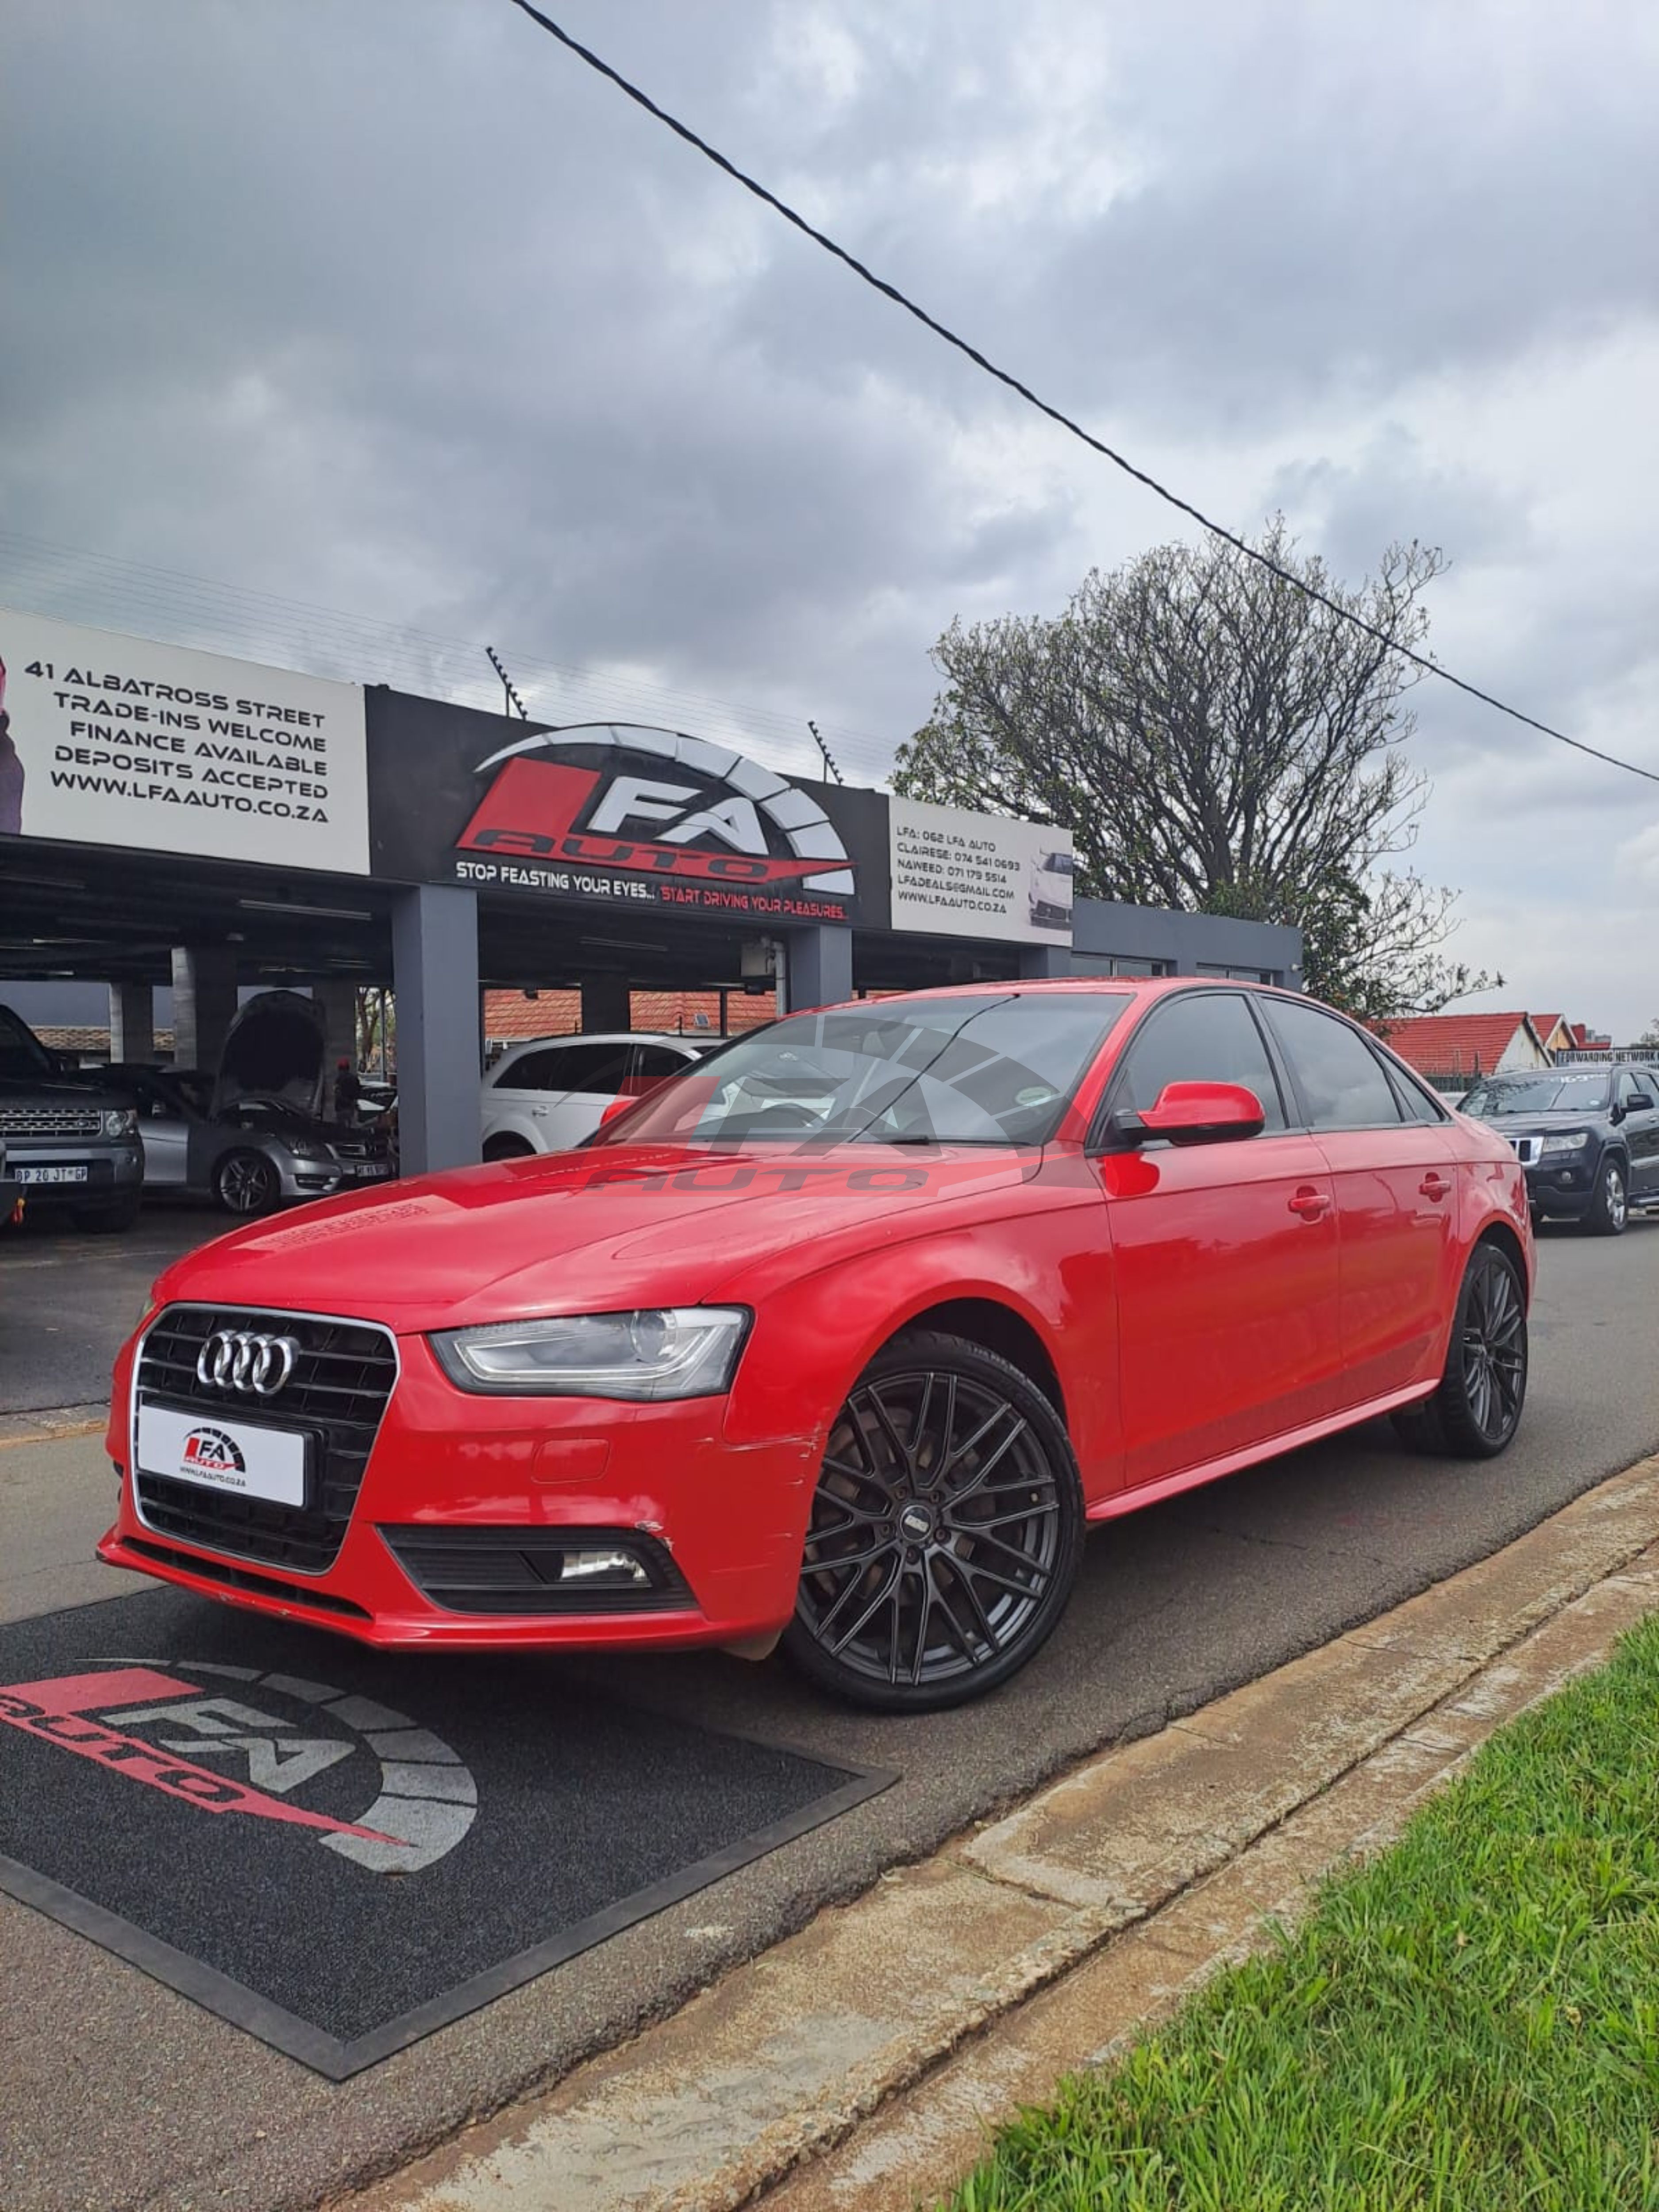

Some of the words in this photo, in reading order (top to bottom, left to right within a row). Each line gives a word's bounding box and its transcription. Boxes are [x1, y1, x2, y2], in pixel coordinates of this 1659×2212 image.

[25, 661, 54, 679] 41
[63, 668, 228, 710] ALBATROSS
[236, 700, 325, 728] STREET
[54, 692, 200, 730] TRADE-INS
[208, 719, 326, 752] WELCOME
[71, 721, 185, 753] FINANCE
[195, 742, 327, 776] AVAILABLE
[55, 746, 192, 779] DEPOSITS
[202, 769, 328, 798] ACCEPTED
[51, 772, 329, 823] WWW.LFAAUTO.CO.ZA
[473, 828, 768, 877] AUTO
[923, 831, 944, 843] 062
[947, 835, 966, 847] LFA
[969, 840, 996, 852] AUTO
[947, 866, 964, 877] 071
[955, 852, 973, 863] 074
[975, 855, 992, 867] 541
[456, 861, 496, 881] STOP
[501, 866, 569, 889] FEASTING
[574, 876, 610, 894] YOUR
[661, 886, 701, 903] START
[704, 891, 748, 910] DRIVING
[751, 896, 781, 912] YOUR
[898, 890, 1007, 913] WWW.LFAAUTO.CO.ZA
[1616, 1050, 1655, 1062] NETWORK
